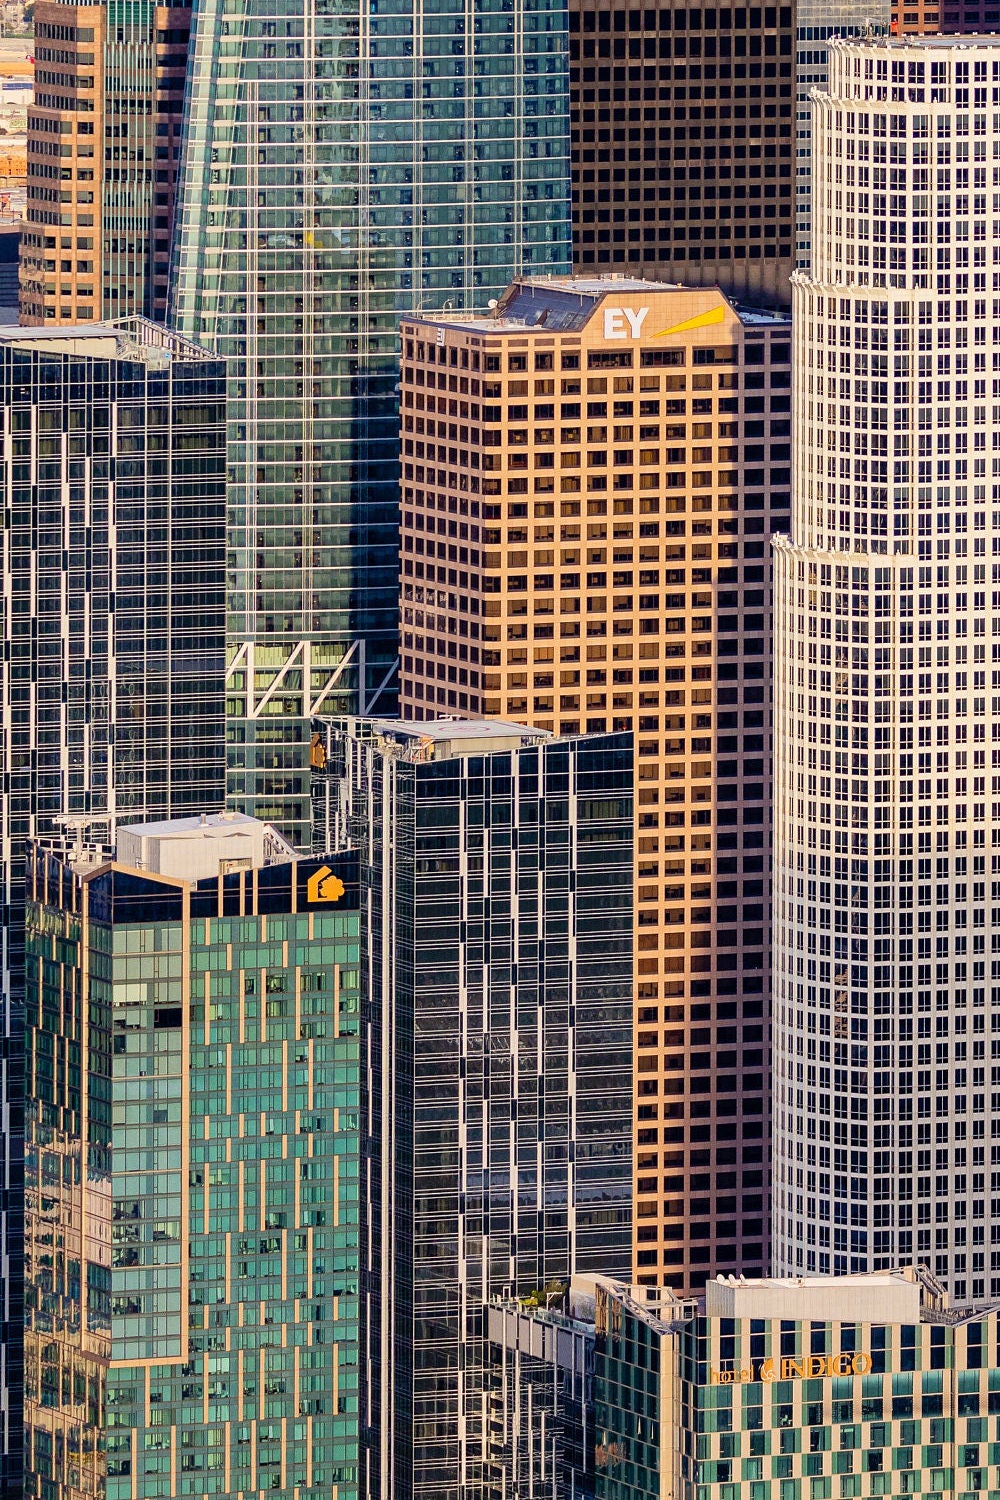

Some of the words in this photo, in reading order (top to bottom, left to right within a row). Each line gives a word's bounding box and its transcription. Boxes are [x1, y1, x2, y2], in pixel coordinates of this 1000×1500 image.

[604, 307, 650, 340] EY
[710, 1363, 754, 1385] hotel
[780, 1352, 873, 1380] INDIGO
